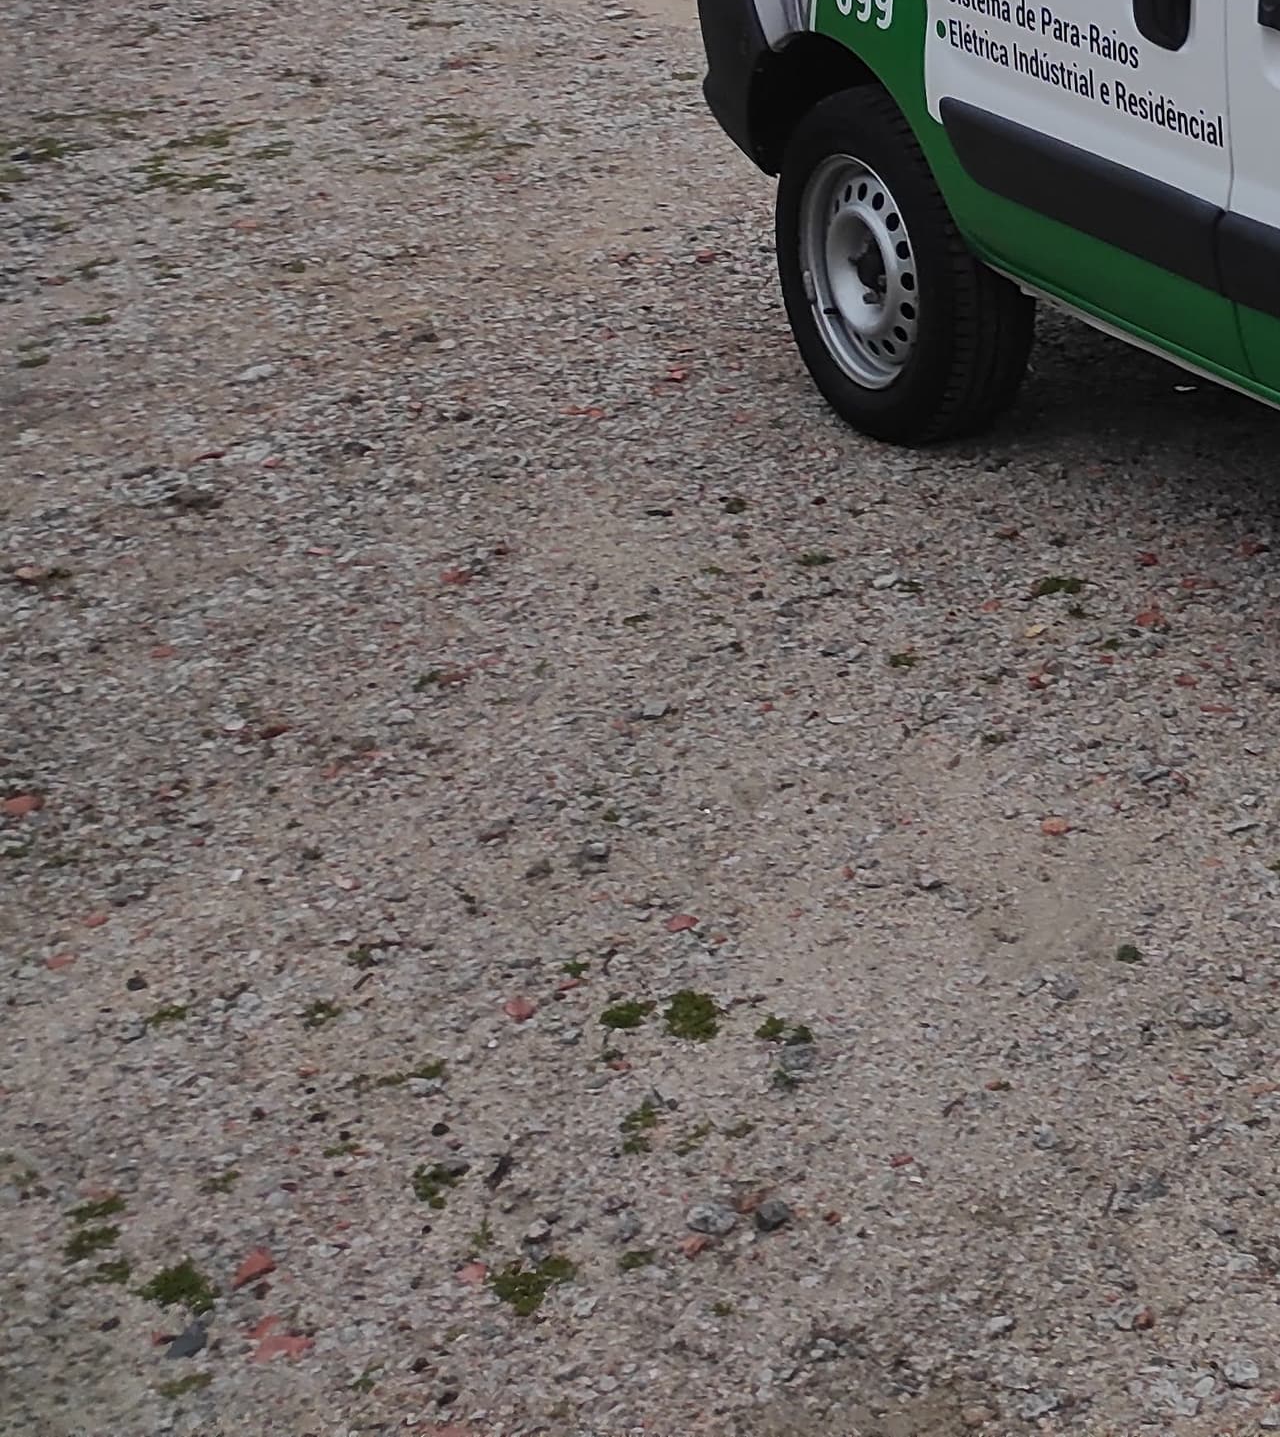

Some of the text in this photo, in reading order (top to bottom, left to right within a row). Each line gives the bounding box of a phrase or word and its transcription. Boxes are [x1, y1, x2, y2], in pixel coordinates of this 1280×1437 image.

[948, 18, 1224, 148] Elétrica Indústrial e Residêncial
[1041, 7, 1140, 69] Para-Raios
